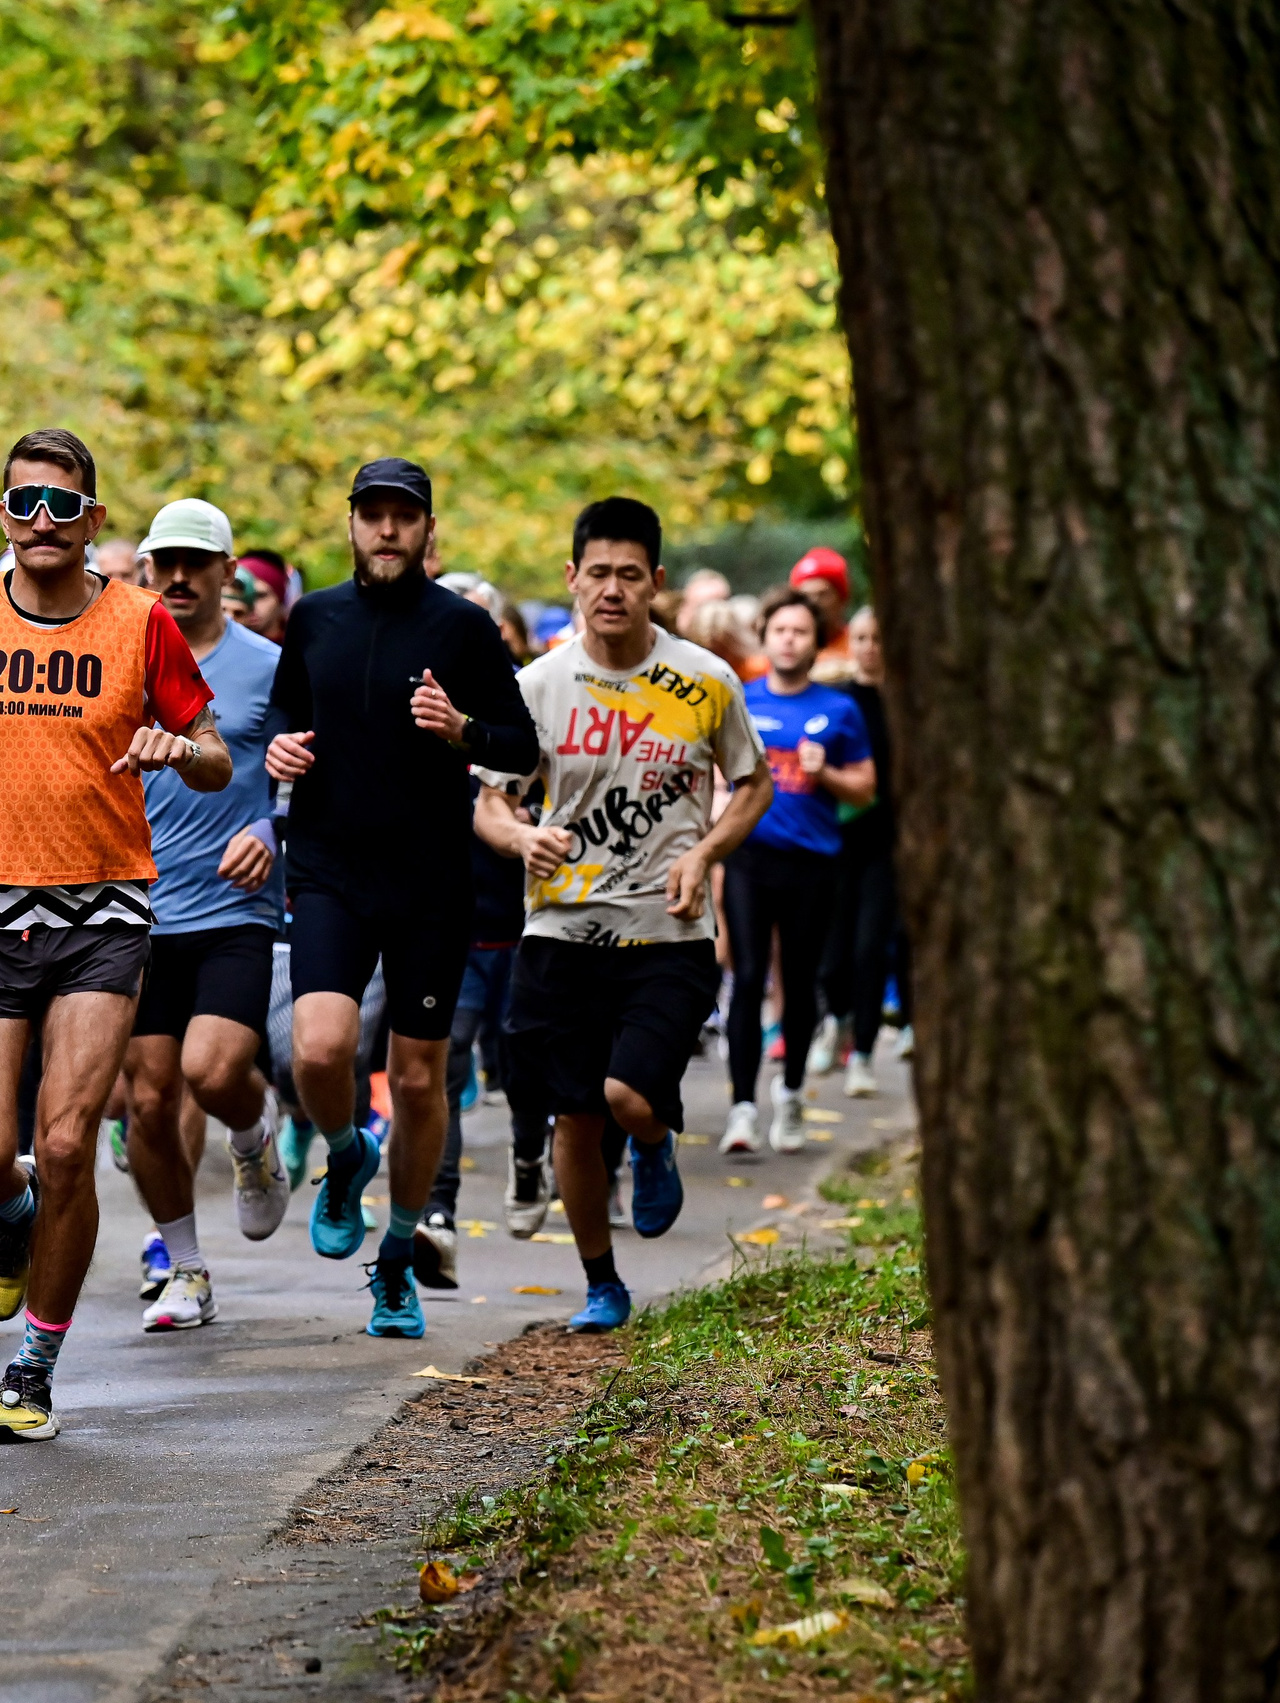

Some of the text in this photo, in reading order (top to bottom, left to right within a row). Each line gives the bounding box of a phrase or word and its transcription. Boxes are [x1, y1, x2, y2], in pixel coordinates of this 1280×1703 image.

[556, 707, 655, 757] ART
[636, 741, 687, 766] THE
[564, 786, 630, 863] OUR
